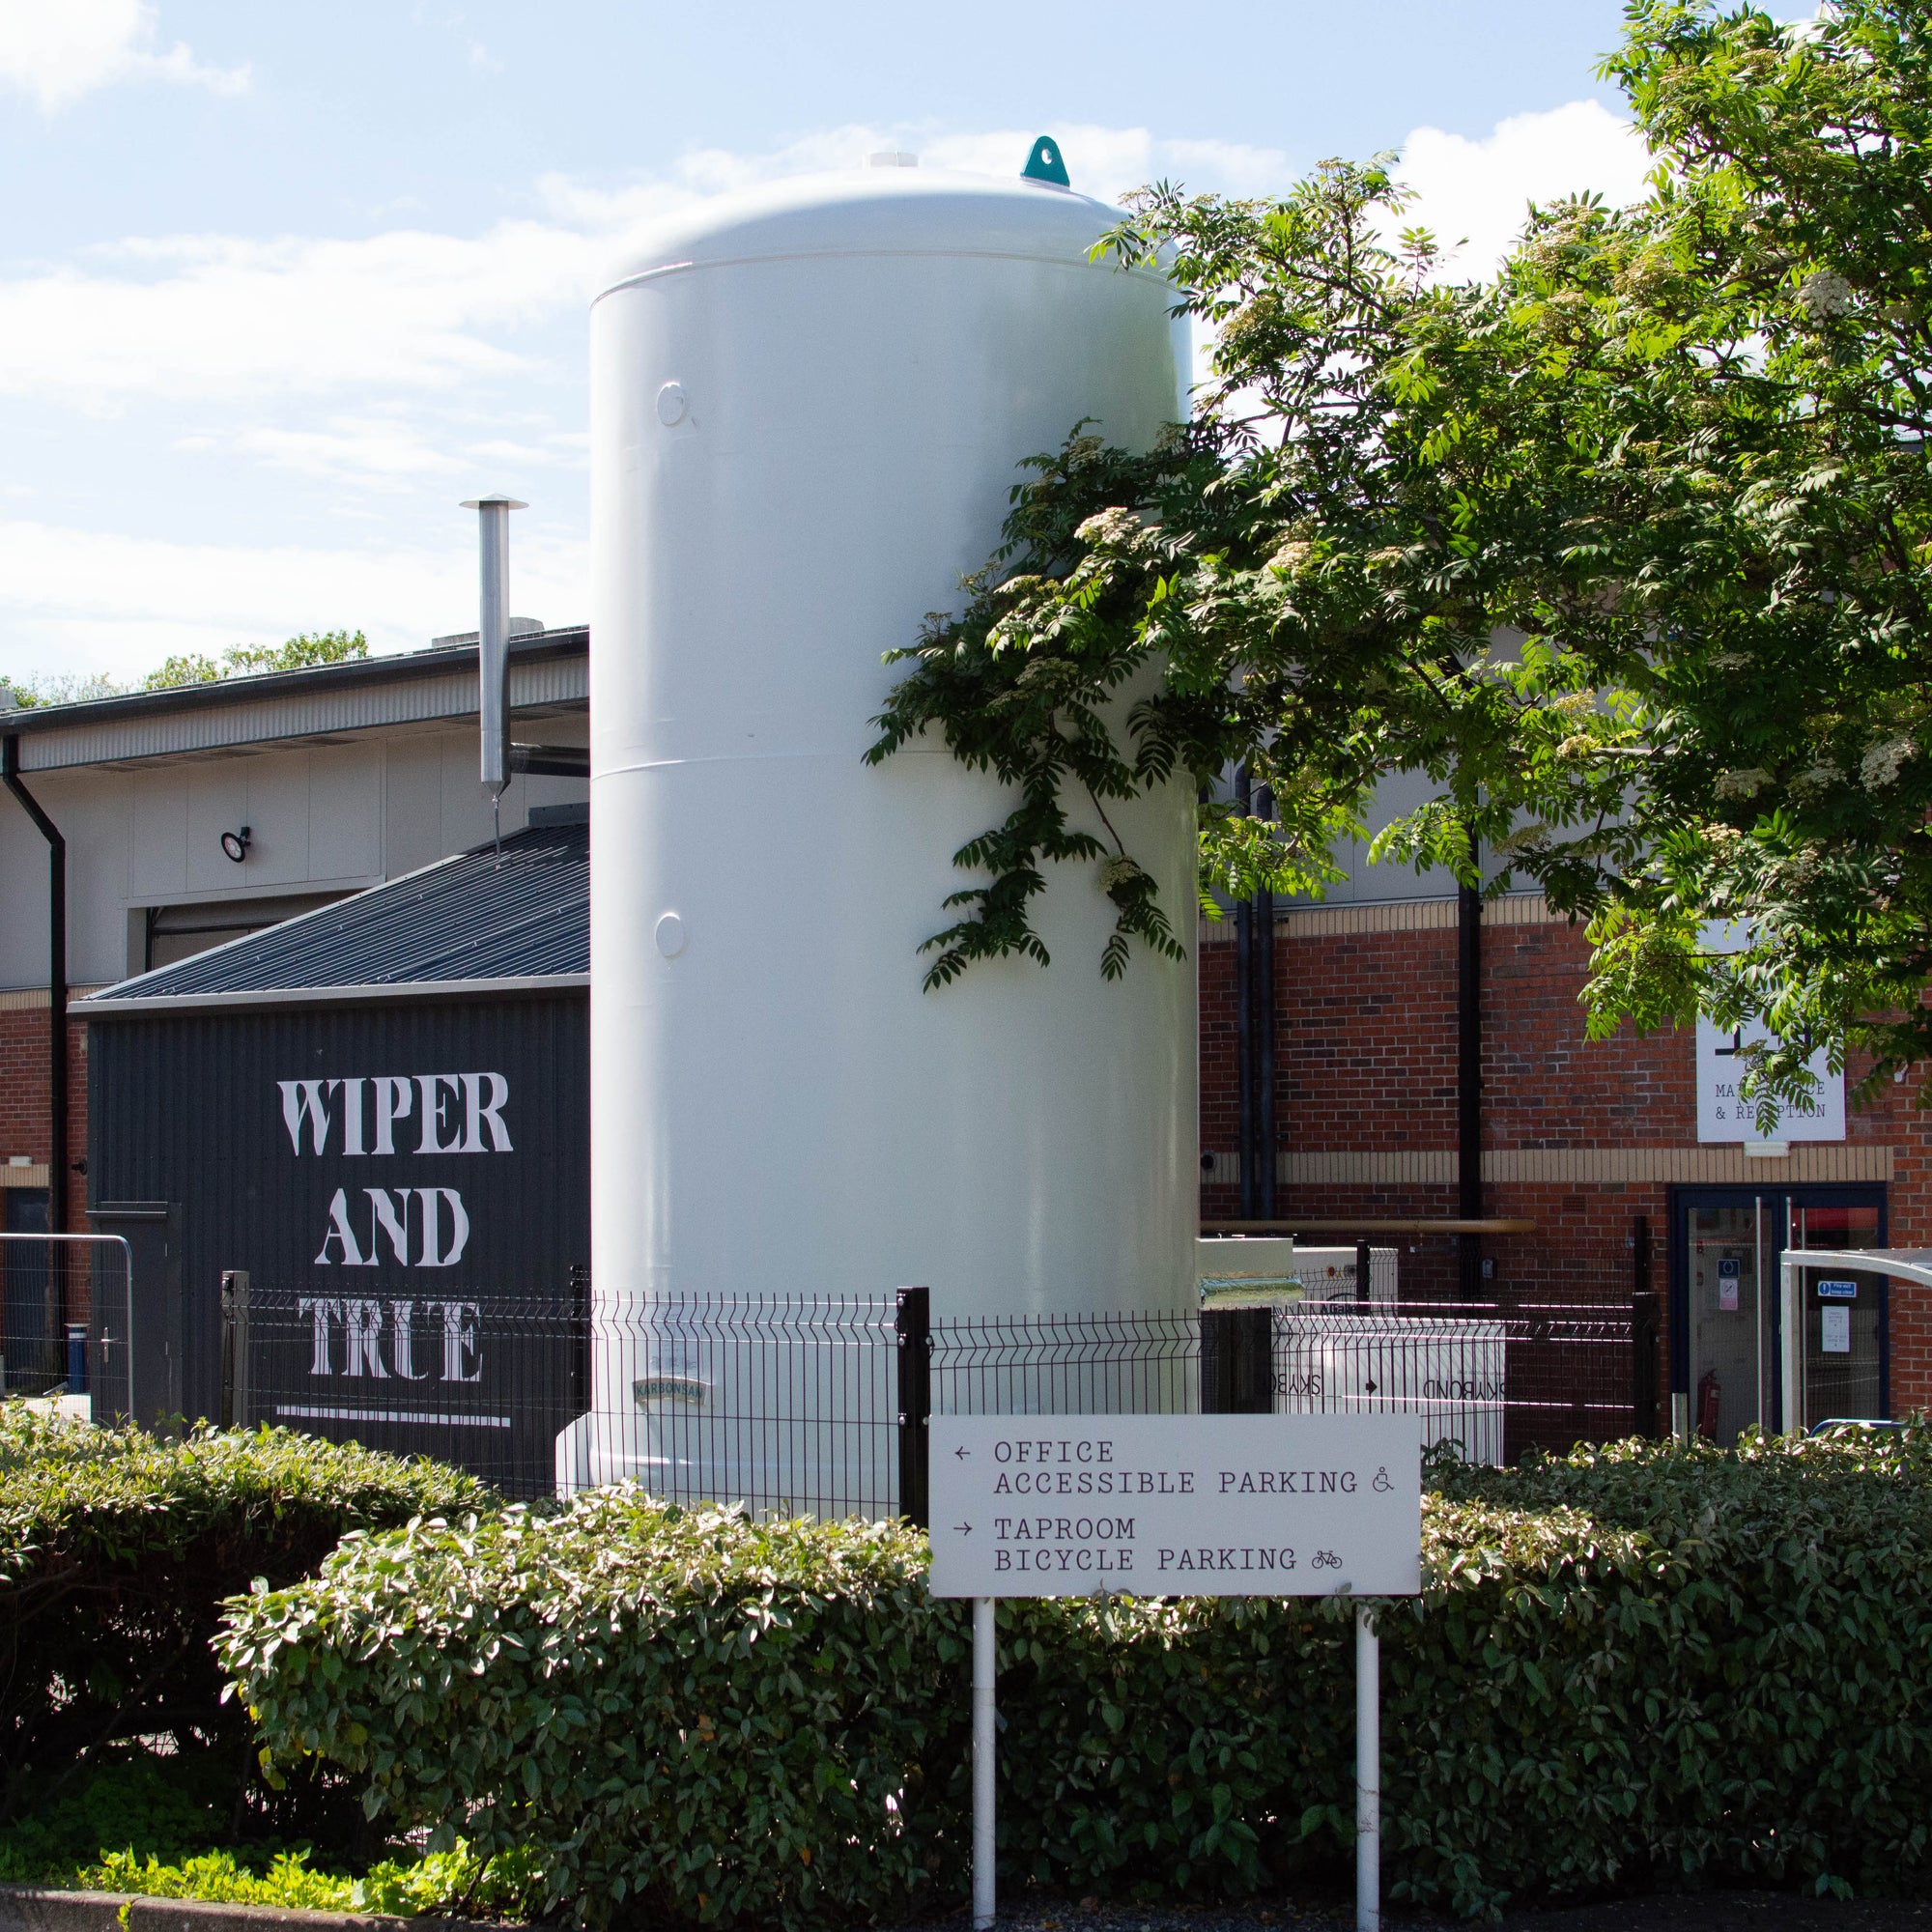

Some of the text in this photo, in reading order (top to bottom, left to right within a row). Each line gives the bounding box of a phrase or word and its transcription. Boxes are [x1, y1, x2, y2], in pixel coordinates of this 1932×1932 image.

[276, 1072, 514, 1156] WIPER
[1716, 1104, 1826, 1120] & REPTION
[314, 1187, 469, 1267] AND
[298, 1297, 483, 1382] TRUE
[637, 1382, 703, 1399] KARBONSAN
[994, 1440, 1114, 1463] OFFICE
[993, 1471, 1358, 1493] ACCESSIBLE PARKING
[994, 1518, 1136, 1540] TAPROOM
[994, 1548, 1297, 1571] BICYCLE PARKING
